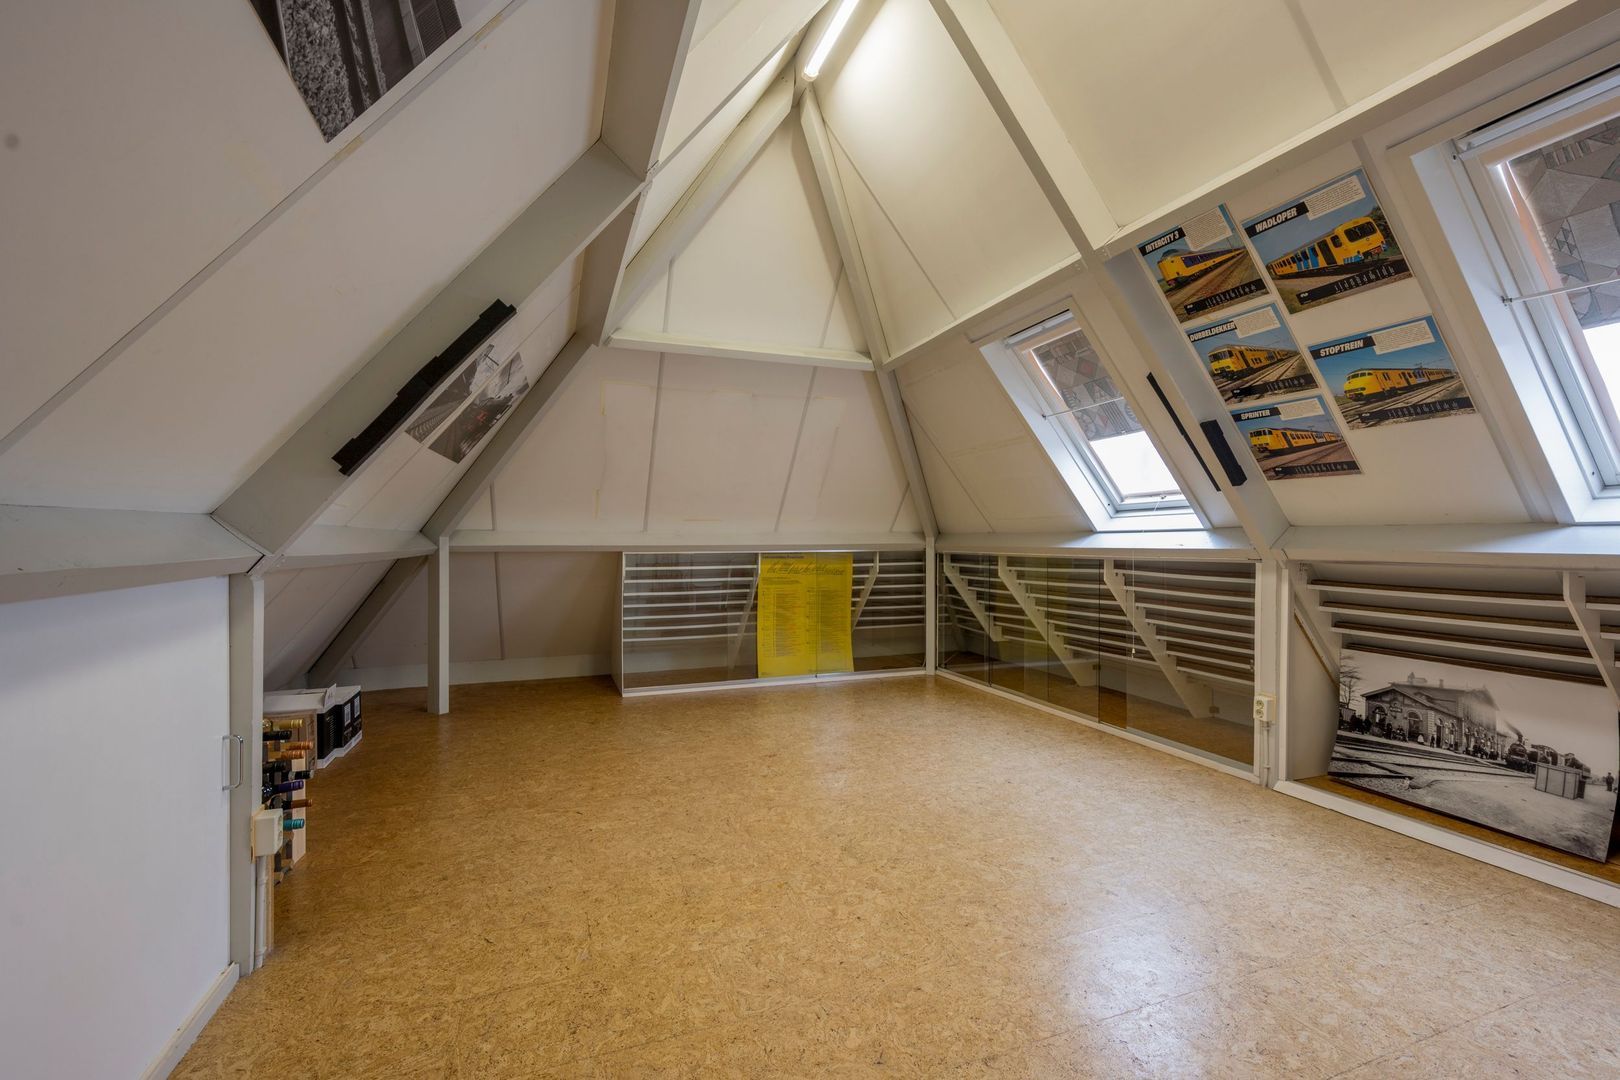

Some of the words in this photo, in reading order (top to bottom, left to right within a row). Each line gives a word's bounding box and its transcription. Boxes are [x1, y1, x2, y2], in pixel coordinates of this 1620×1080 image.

[1255, 207, 1298, 233] WADLOPER
[1145, 232, 1174, 253] INTERCITY
[1189, 321, 1236, 341] DUBBELDEKKER
[1319, 339, 1364, 357] STOPTREIN
[1241, 409, 1271, 420] SPRINTER
